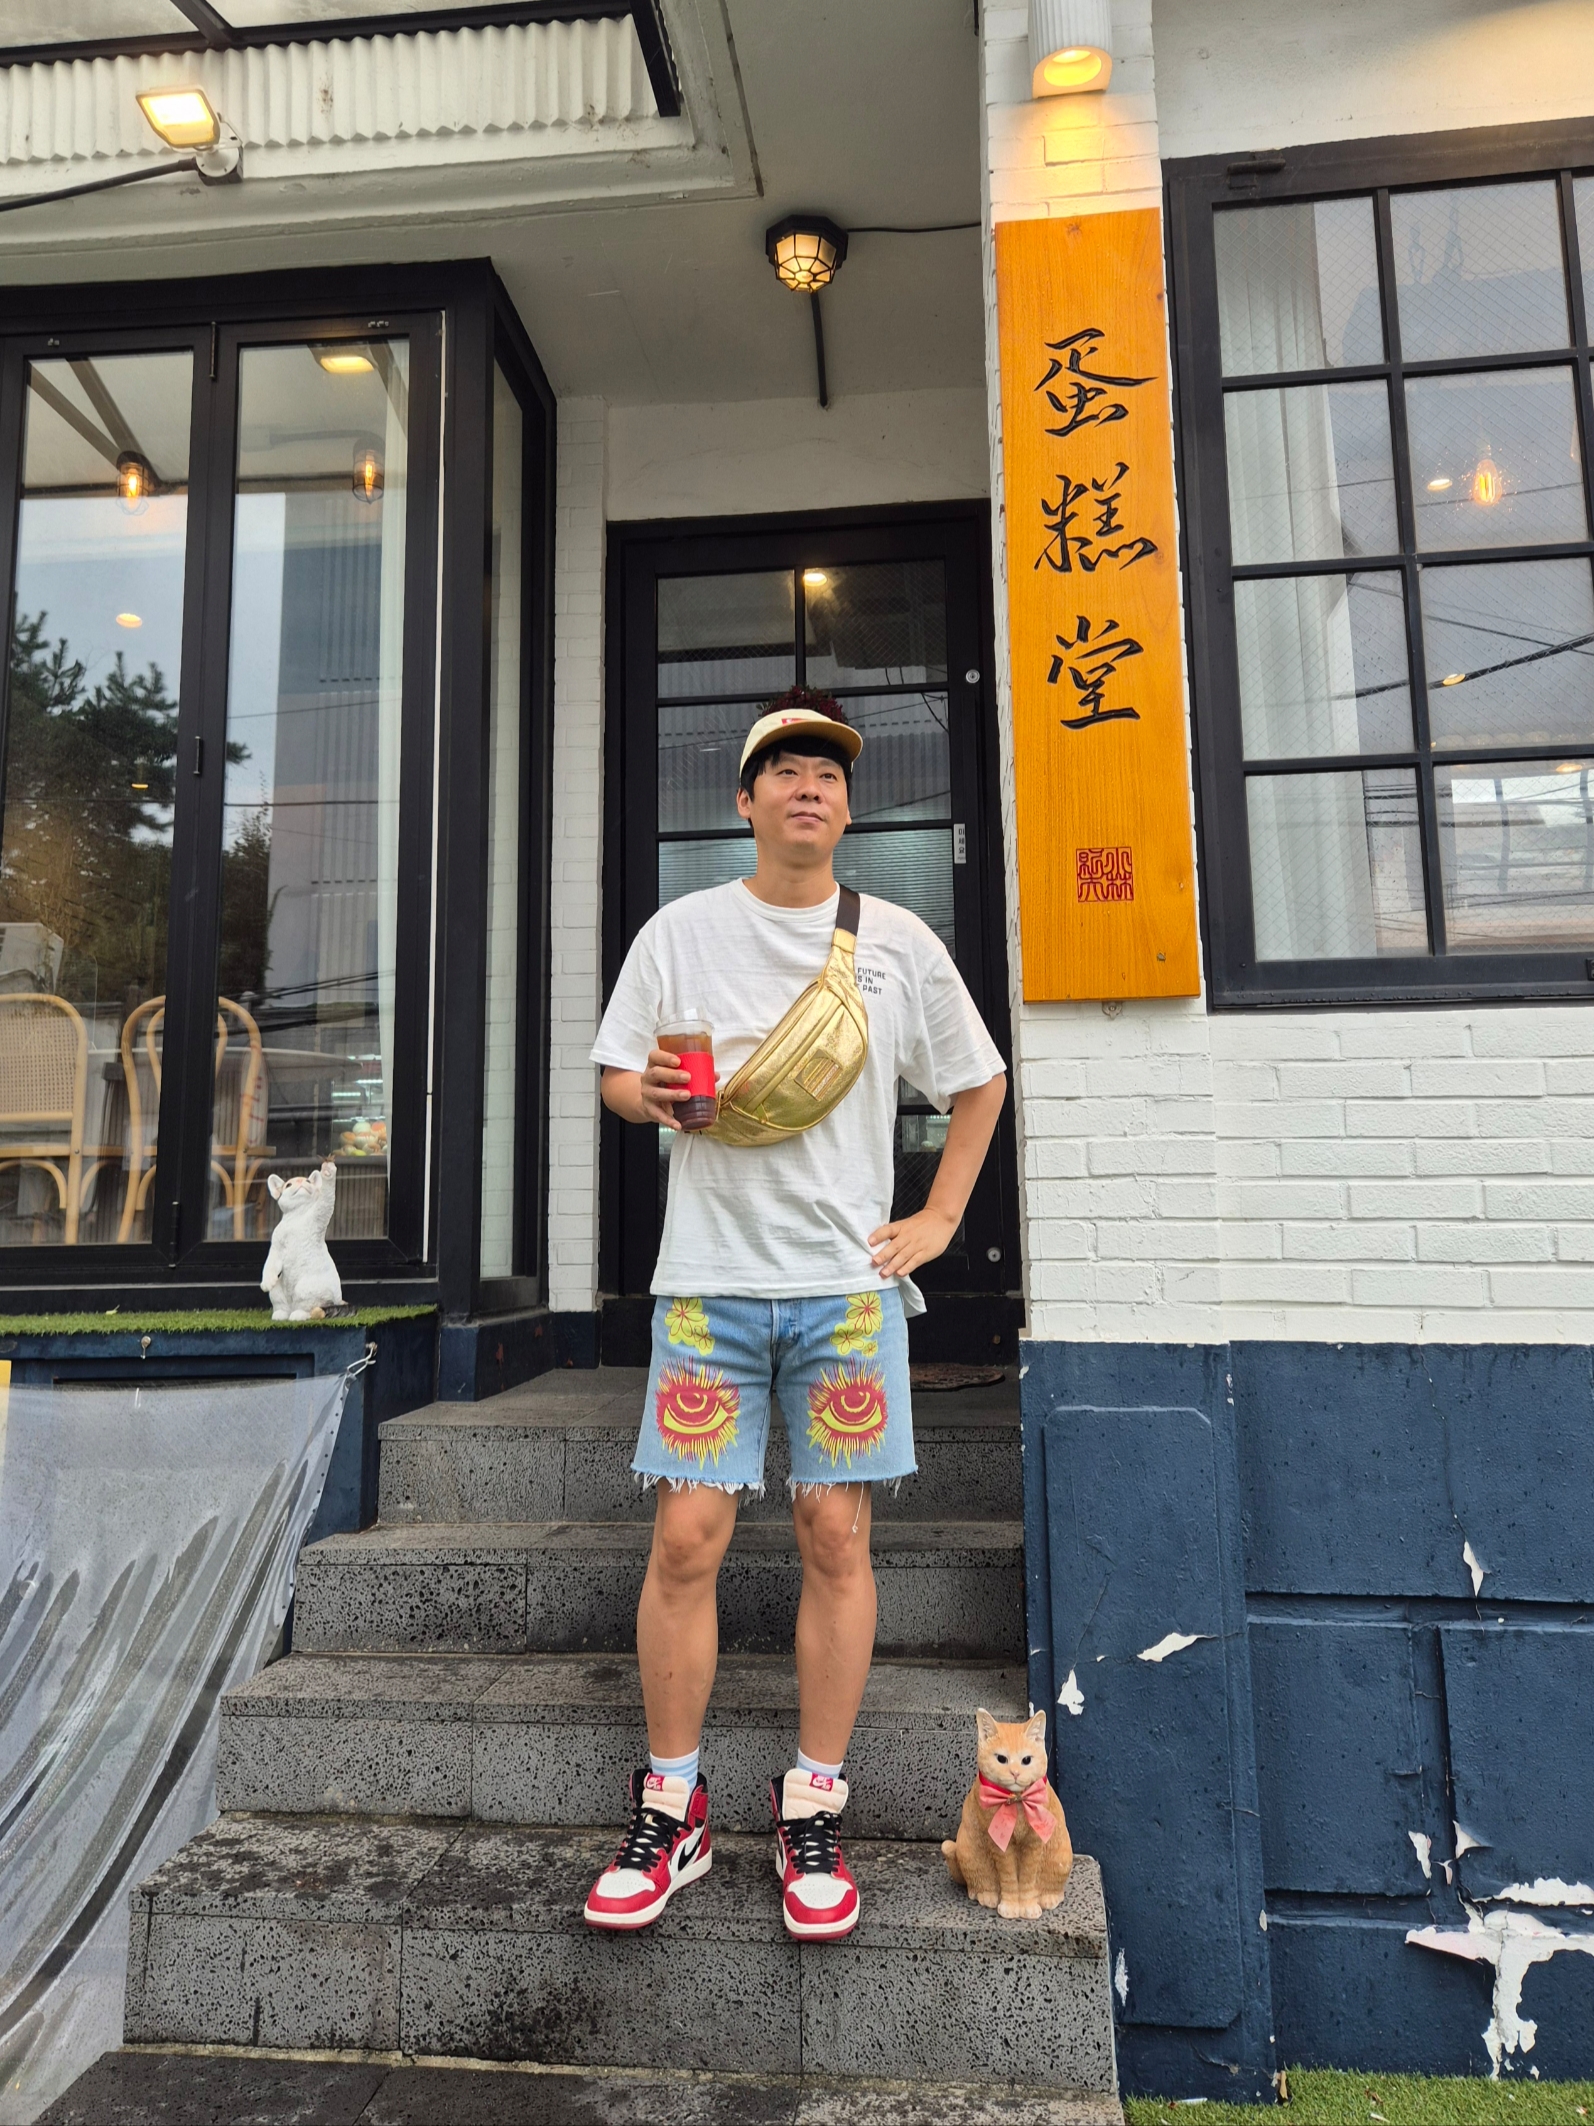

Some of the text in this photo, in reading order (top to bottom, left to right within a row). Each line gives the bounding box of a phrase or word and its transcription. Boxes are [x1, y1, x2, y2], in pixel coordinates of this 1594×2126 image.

[1034, 327, 1159, 730] 蛋糕堂
[857, 967, 886, 980] FUTURE
[865, 976, 873, 984] IN
[862, 984, 882, 995] PAST
